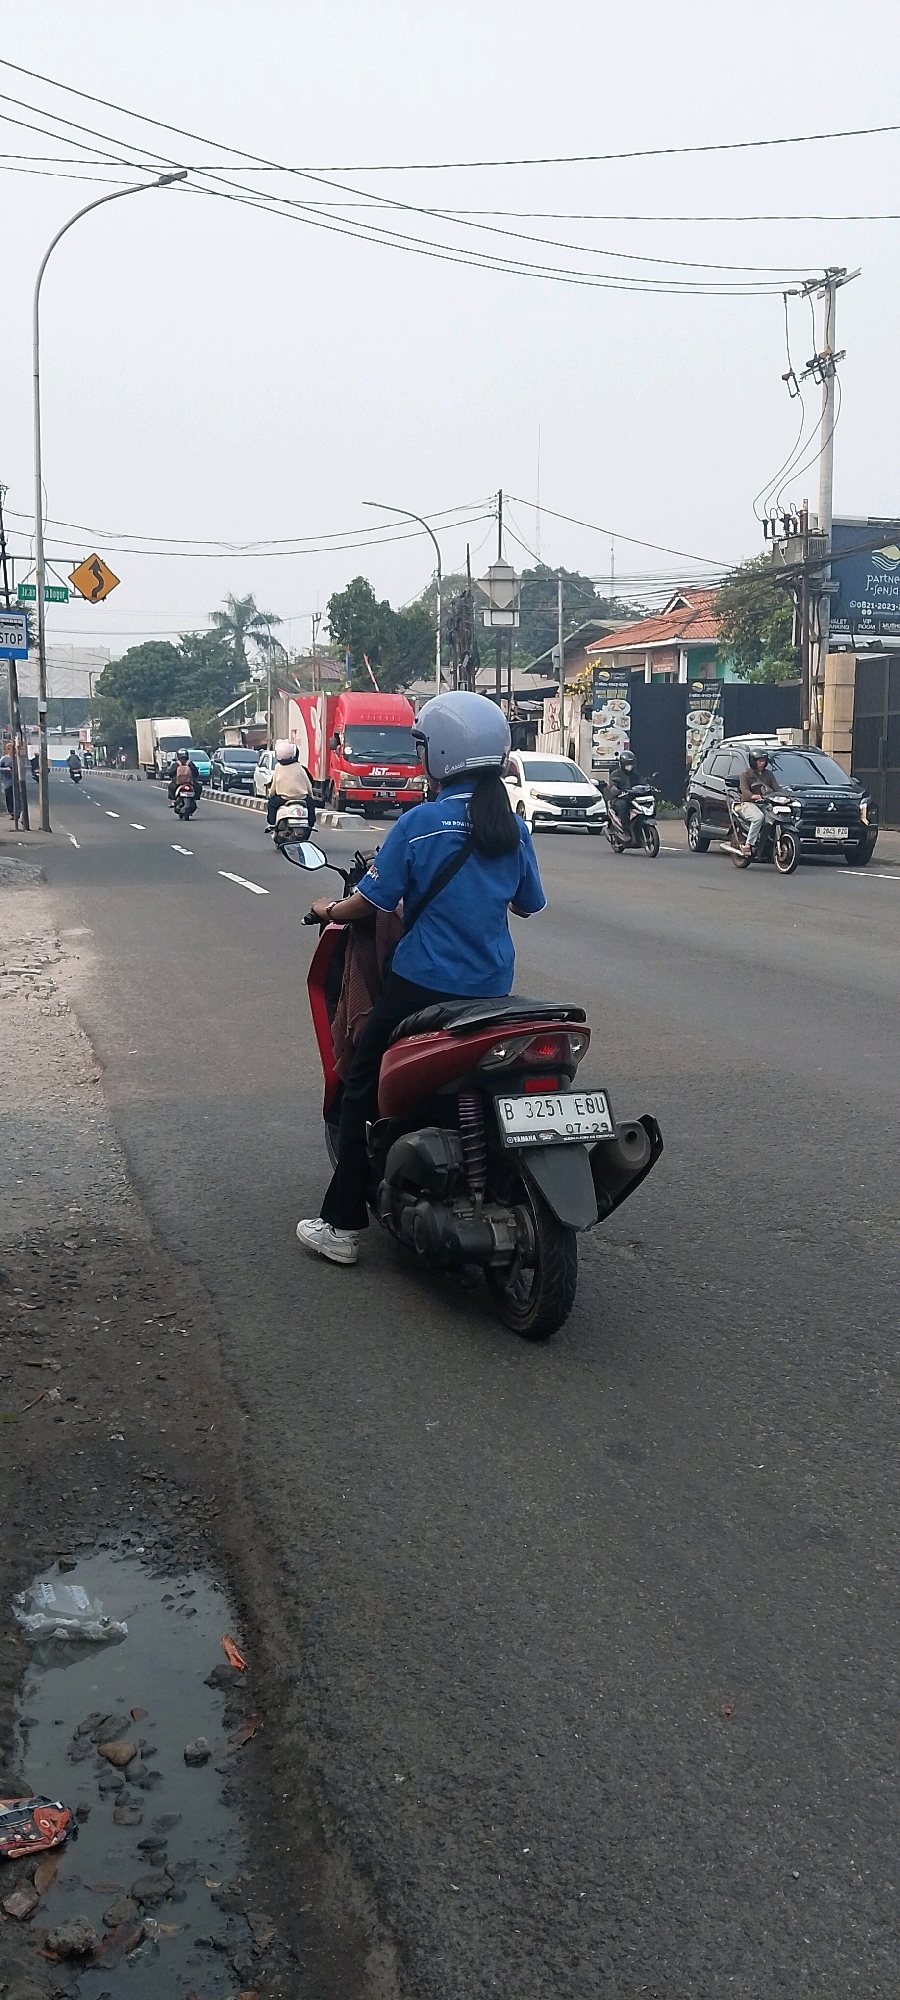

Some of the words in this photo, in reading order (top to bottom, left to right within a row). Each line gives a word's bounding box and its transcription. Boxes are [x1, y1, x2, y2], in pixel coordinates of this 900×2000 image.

[368, 767, 389, 776] J&T
[504, 1103, 514, 1120] B
[524, 1099, 564, 1118] 3251
[513, 1134, 537, 1143] YAMAHA
